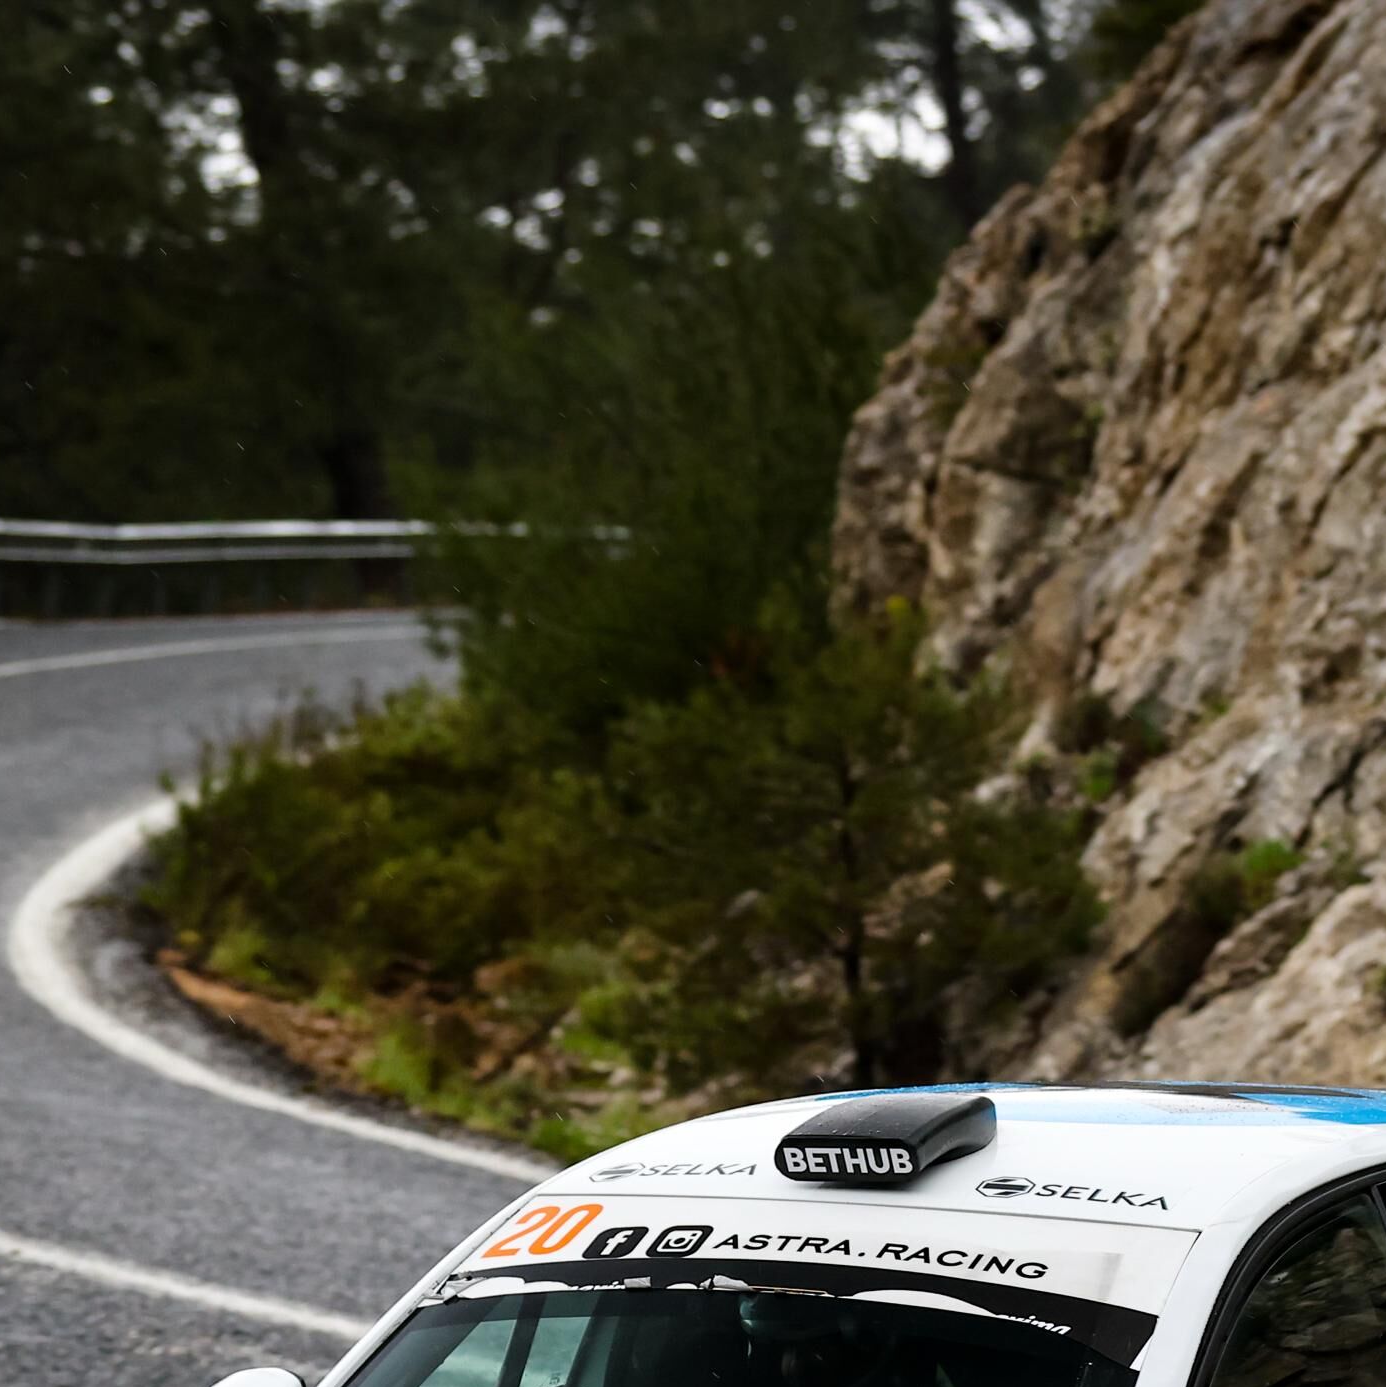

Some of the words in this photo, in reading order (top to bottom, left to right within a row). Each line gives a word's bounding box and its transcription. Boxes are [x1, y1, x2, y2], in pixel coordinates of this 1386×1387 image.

[644, 1160, 758, 1179] SELKA
[783, 1146, 913, 1177] BETHUB
[1036, 1183, 1169, 1212] SELKA
[480, 1203, 604, 1260] 20
